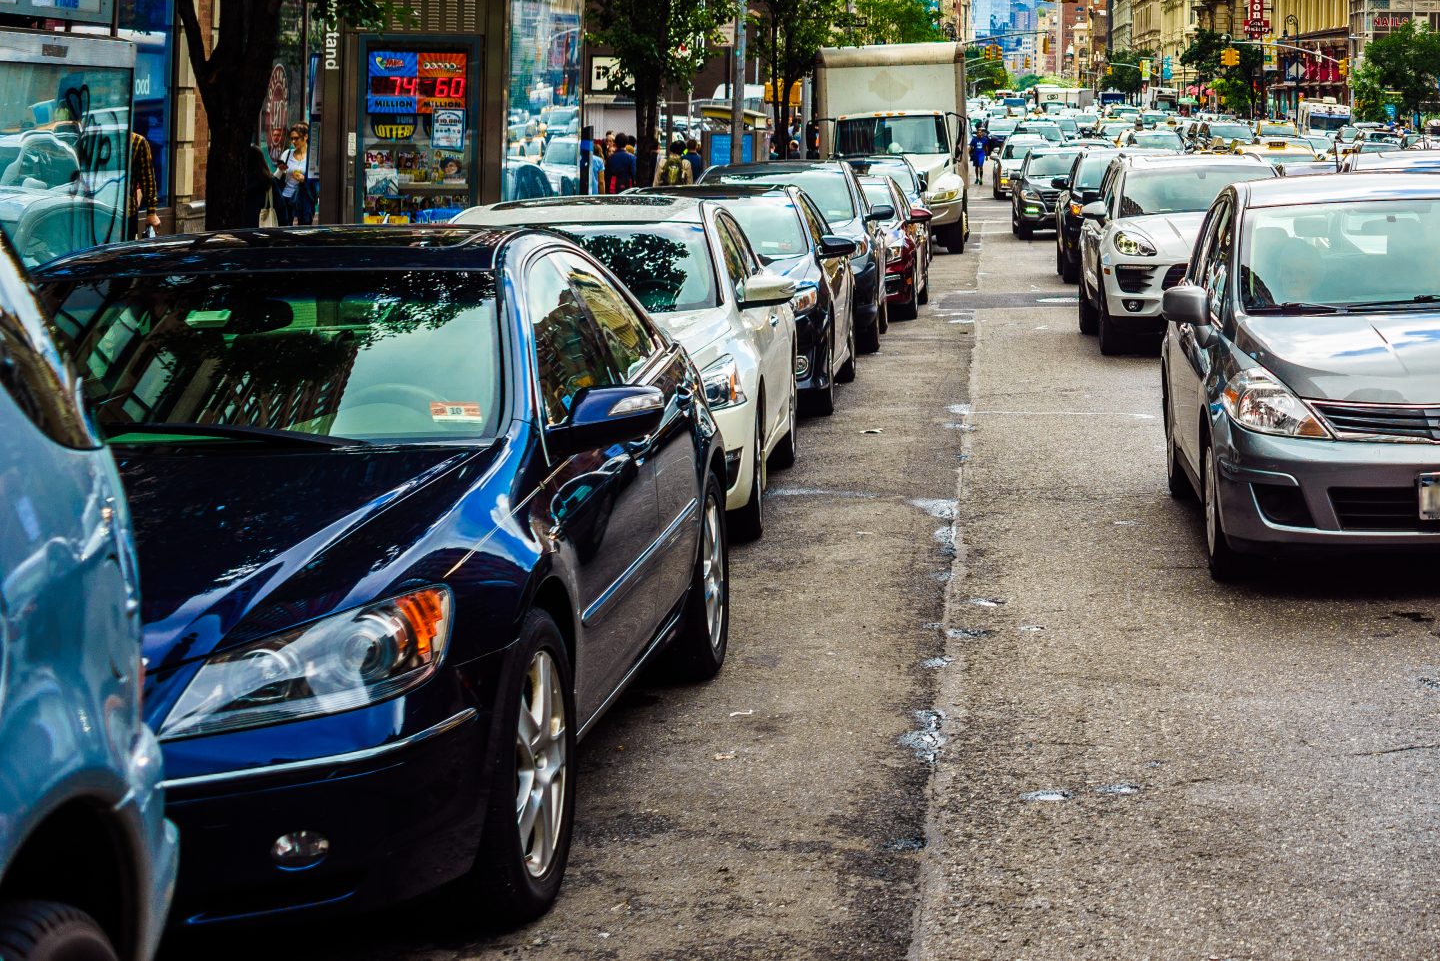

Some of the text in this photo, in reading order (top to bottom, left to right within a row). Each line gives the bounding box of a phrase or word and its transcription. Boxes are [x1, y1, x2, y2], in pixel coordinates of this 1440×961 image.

[1373, 16, 1409, 27] NAILS
[375, 124, 415, 138] LOTTERY
[450, 407, 462, 415] 10
